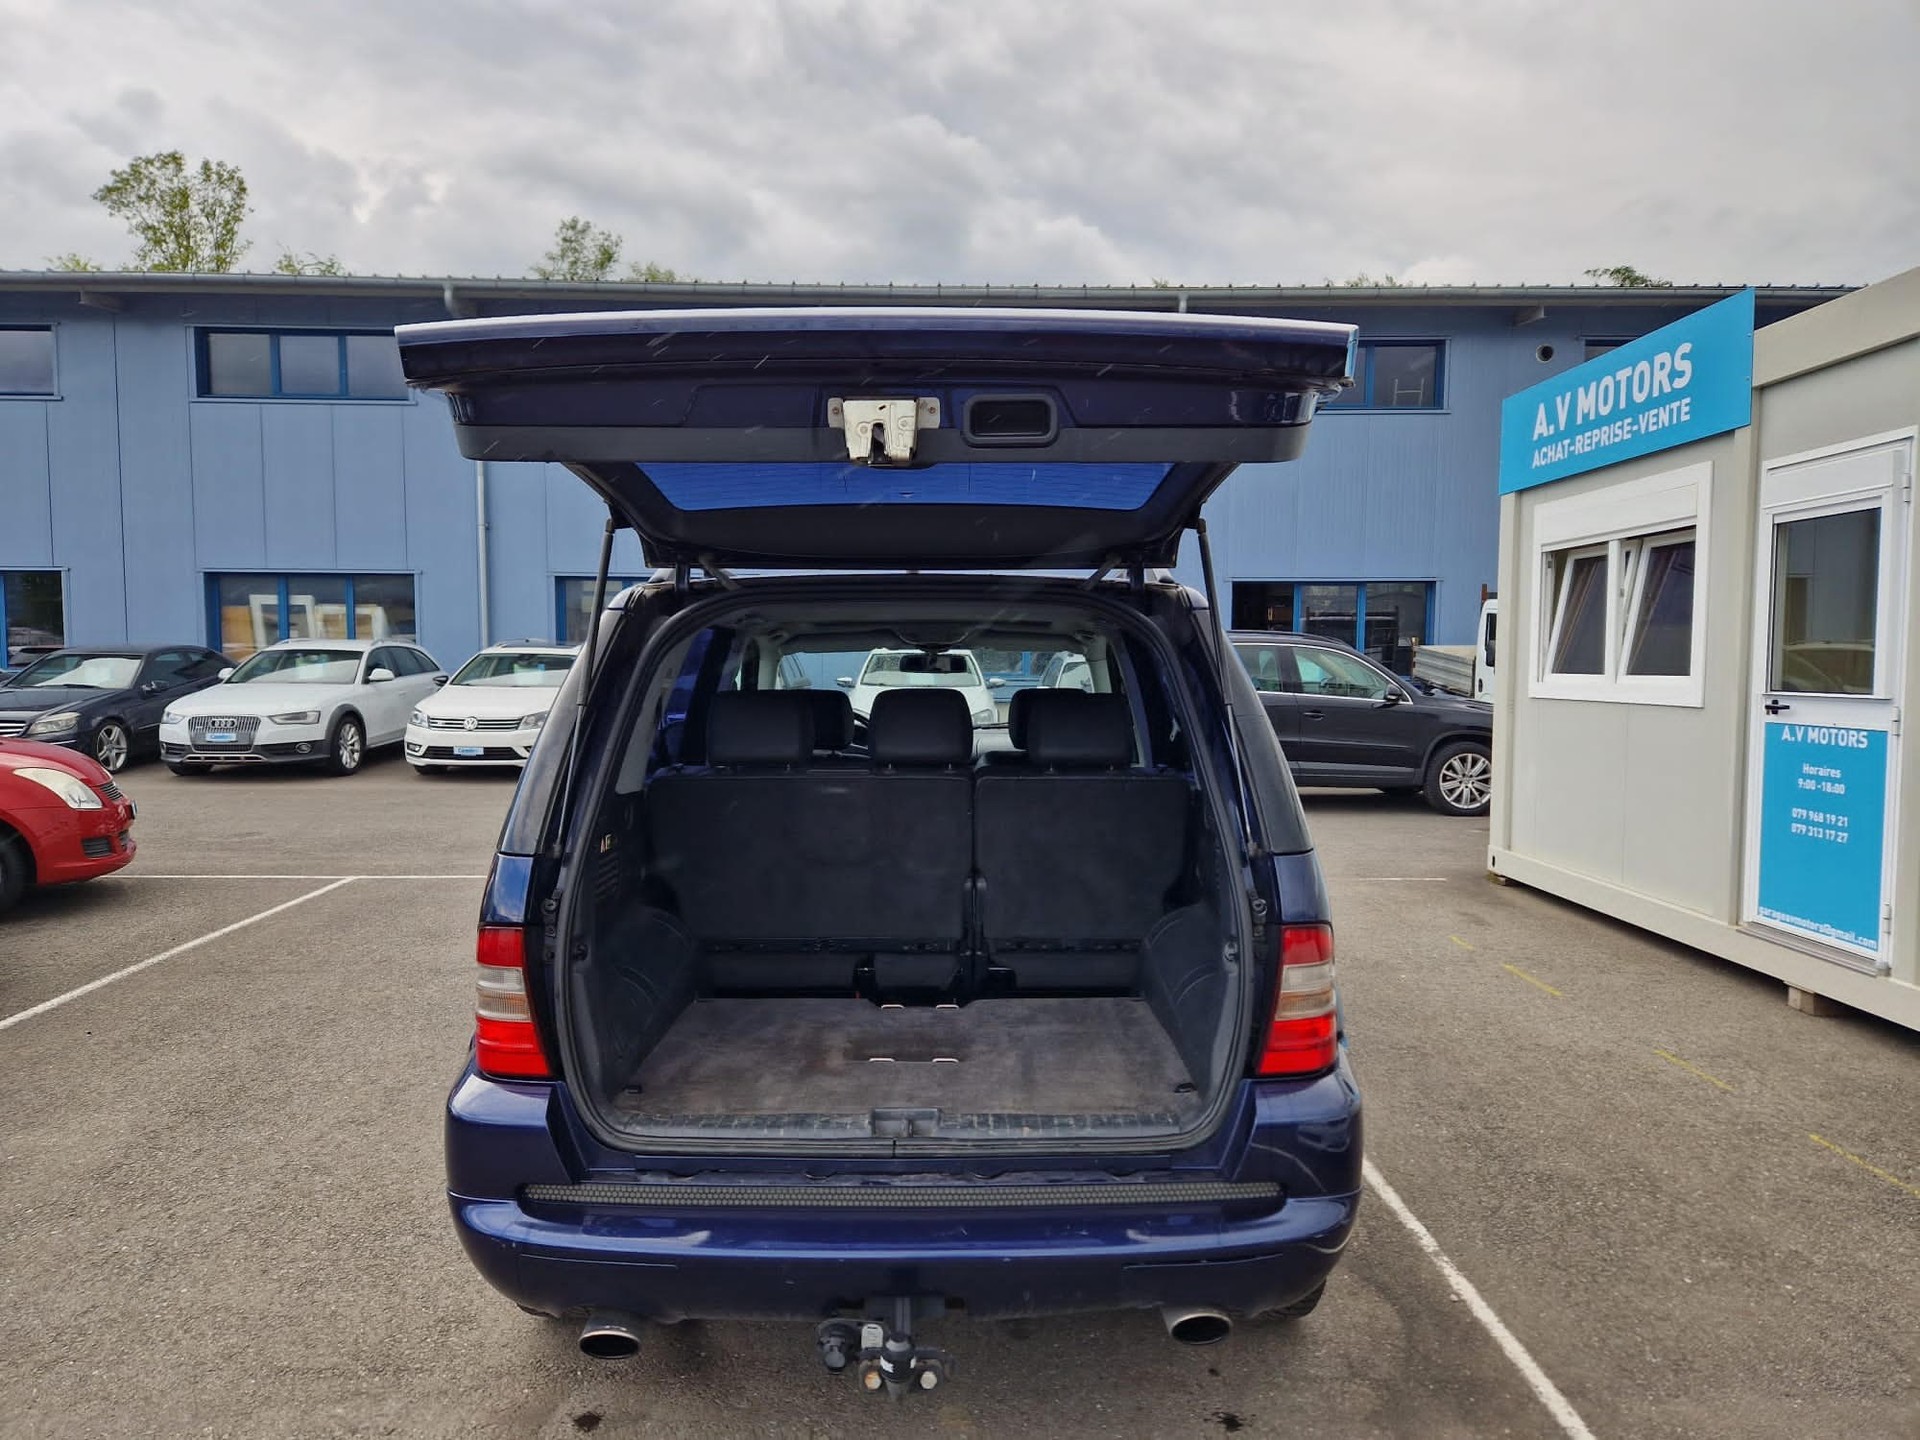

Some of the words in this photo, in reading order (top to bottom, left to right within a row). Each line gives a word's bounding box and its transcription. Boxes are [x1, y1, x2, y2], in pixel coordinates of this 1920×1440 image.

[1533, 391, 1571, 441] A.V
[1576, 342, 1693, 425] MOTORS
[1532, 398, 1691, 469] ACHAT-REPRISE-VENTE
[1781, 725, 1804, 743] A.V
[1807, 727, 1868, 749] MOTORS
[1802, 763, 1841, 778] Horaires
[1792, 808, 1807, 819] 079
[1826, 813, 1836, 825] 19
[1837, 815, 1848, 827] 21
[1791, 823, 1806, 835] 079
[1825, 829, 1836, 841] 17
[1836, 831, 1849, 844] 27
